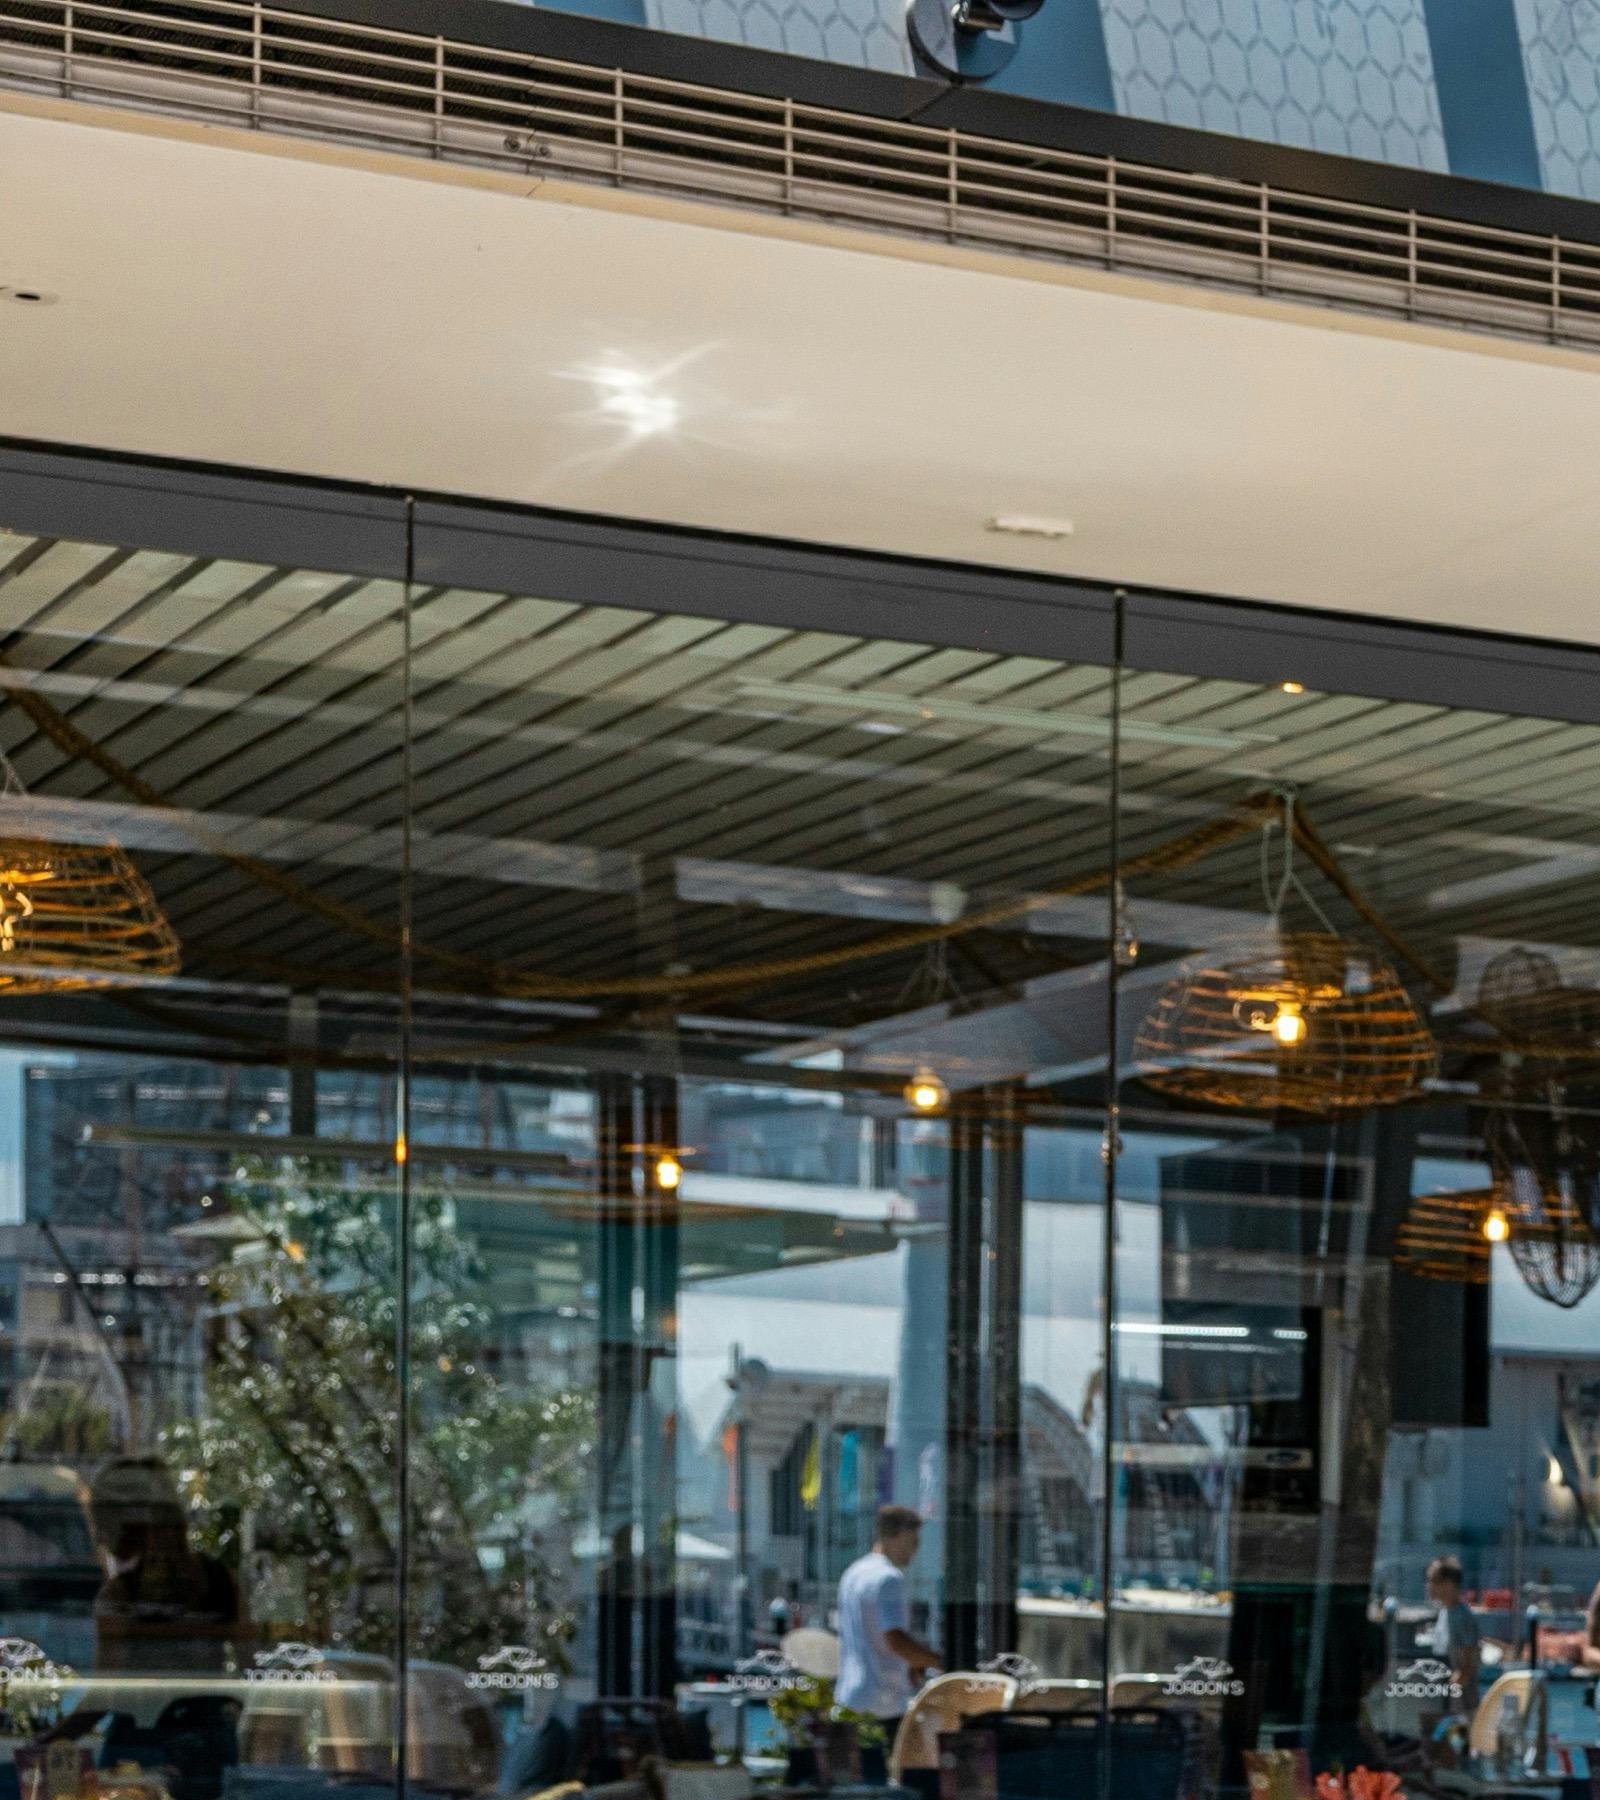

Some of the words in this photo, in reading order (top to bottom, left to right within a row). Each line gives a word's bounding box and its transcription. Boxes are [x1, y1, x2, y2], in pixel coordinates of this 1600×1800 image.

[464, 1672, 559, 1689] JORDON'S
[1162, 1680, 1244, 1696] JORDON'S
[1384, 1682, 1463, 1698] JORDON'S
